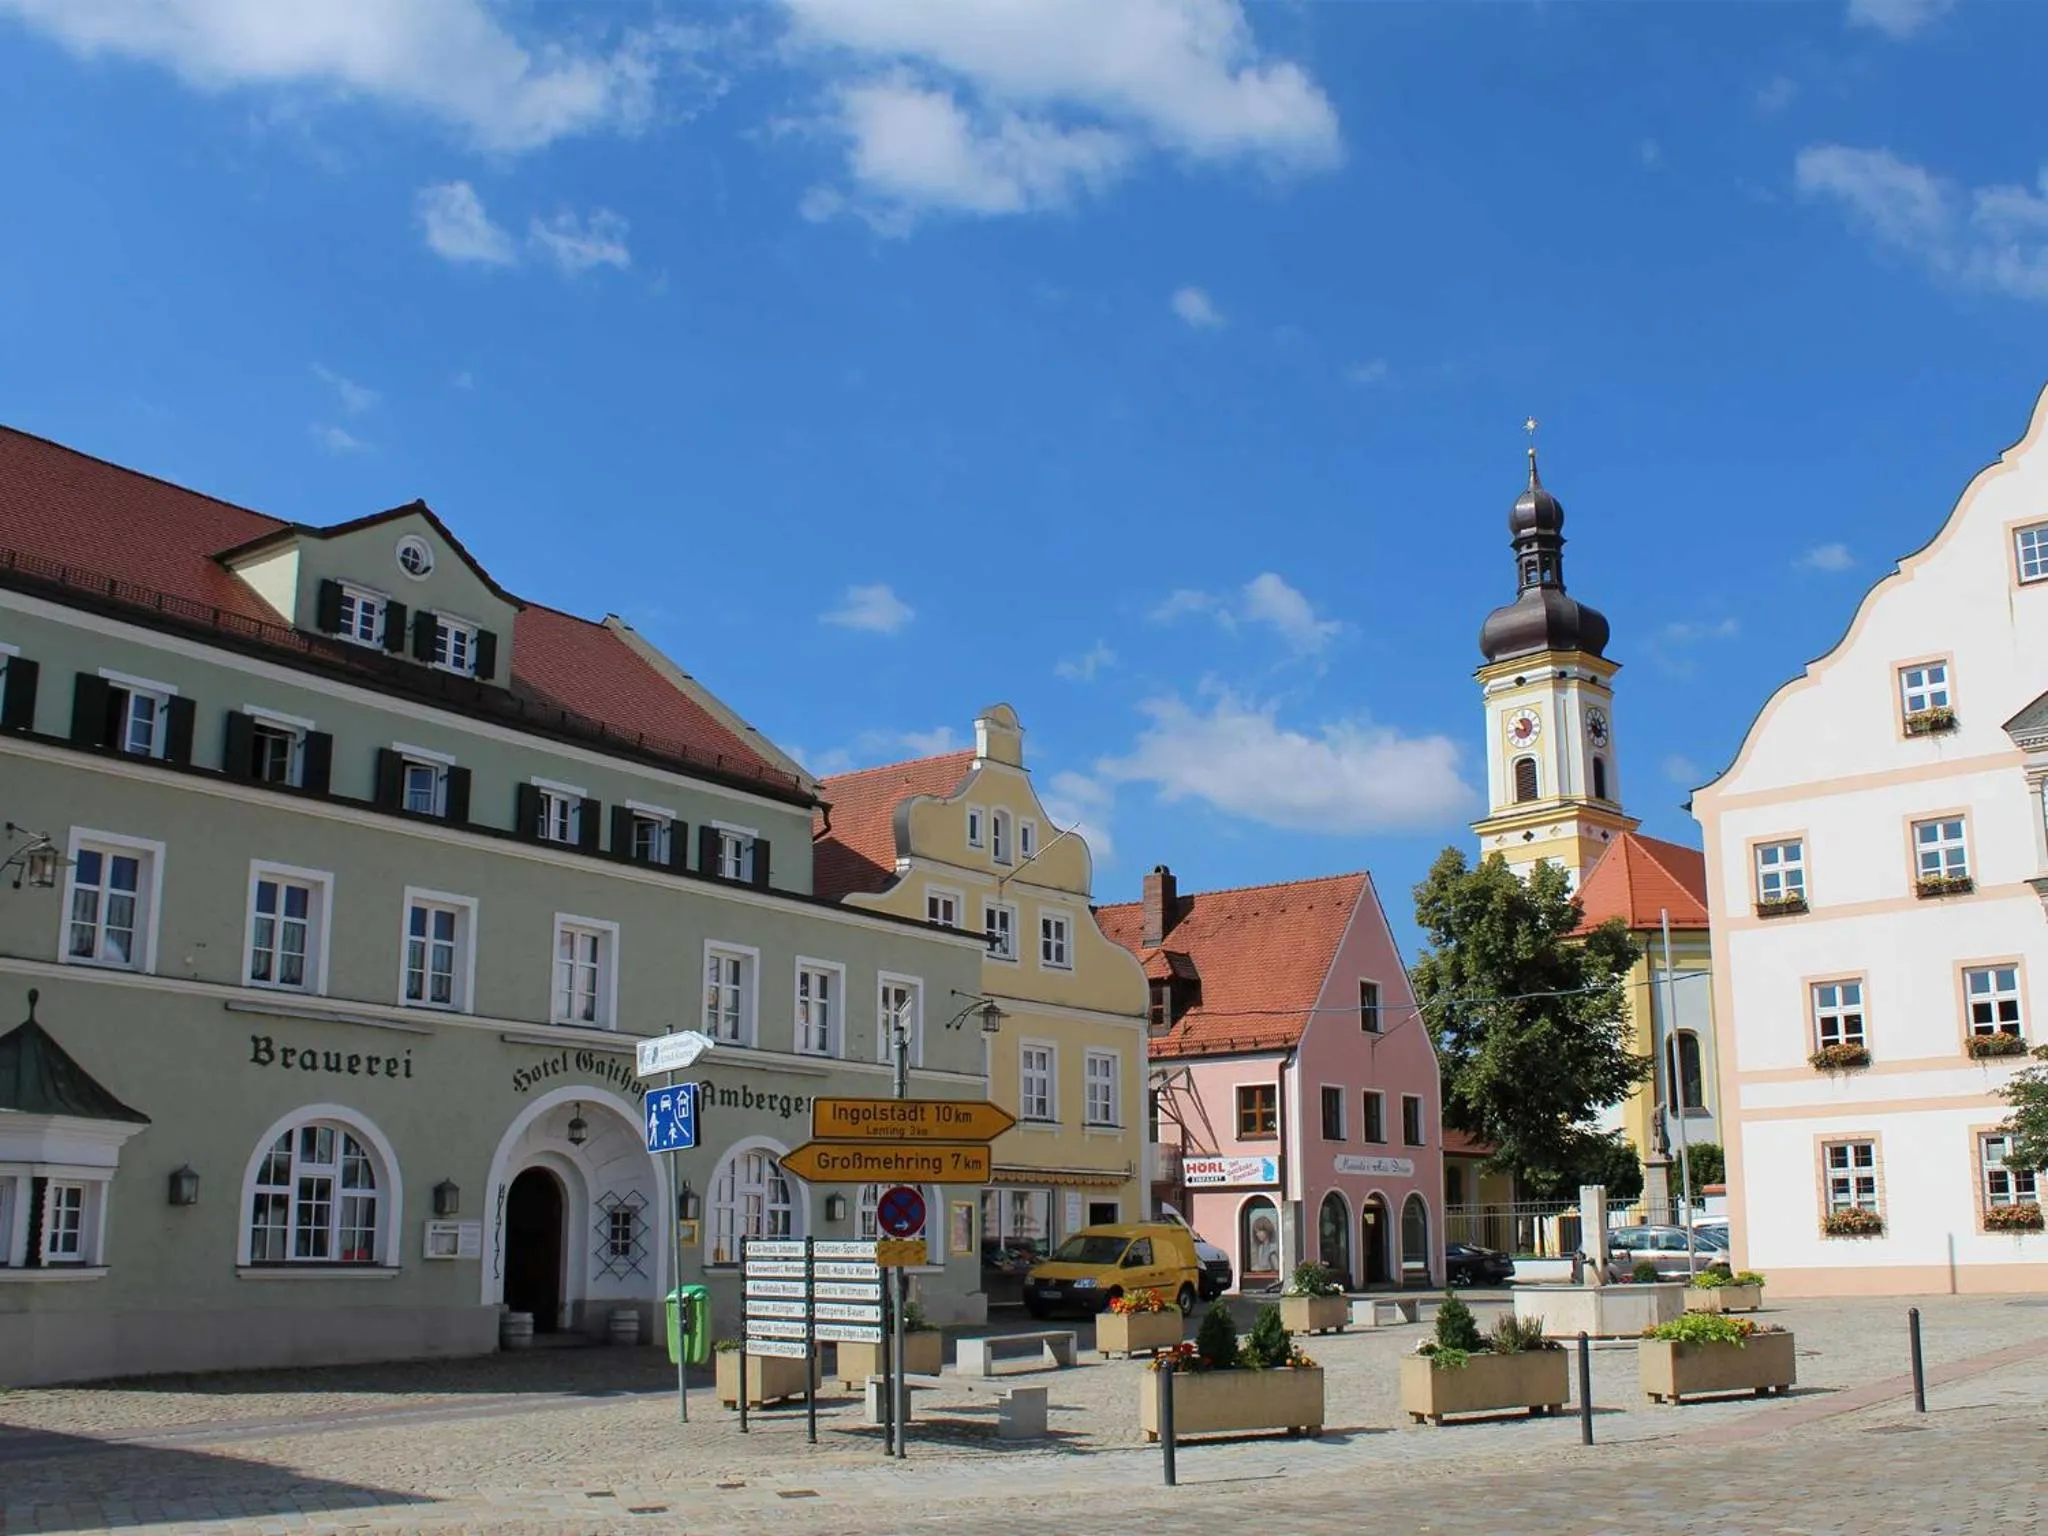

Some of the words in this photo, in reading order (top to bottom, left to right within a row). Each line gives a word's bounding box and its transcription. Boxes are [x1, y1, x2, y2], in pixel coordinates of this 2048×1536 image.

[250, 1034, 413, 1079] Brauerei
[512, 1051, 568, 1093] Hotel
[832, 1103, 925, 1125] Ingolstadt
[935, 1105, 952, 1122] 10
[955, 1109, 973, 1123] km
[866, 1125, 905, 1138] Lenting
[816, 1152, 943, 1174] Großmehring
[951, 1153, 961, 1170] 7
[964, 1156, 982, 1170] km
[1186, 1162, 1225, 1174] HÖRL
